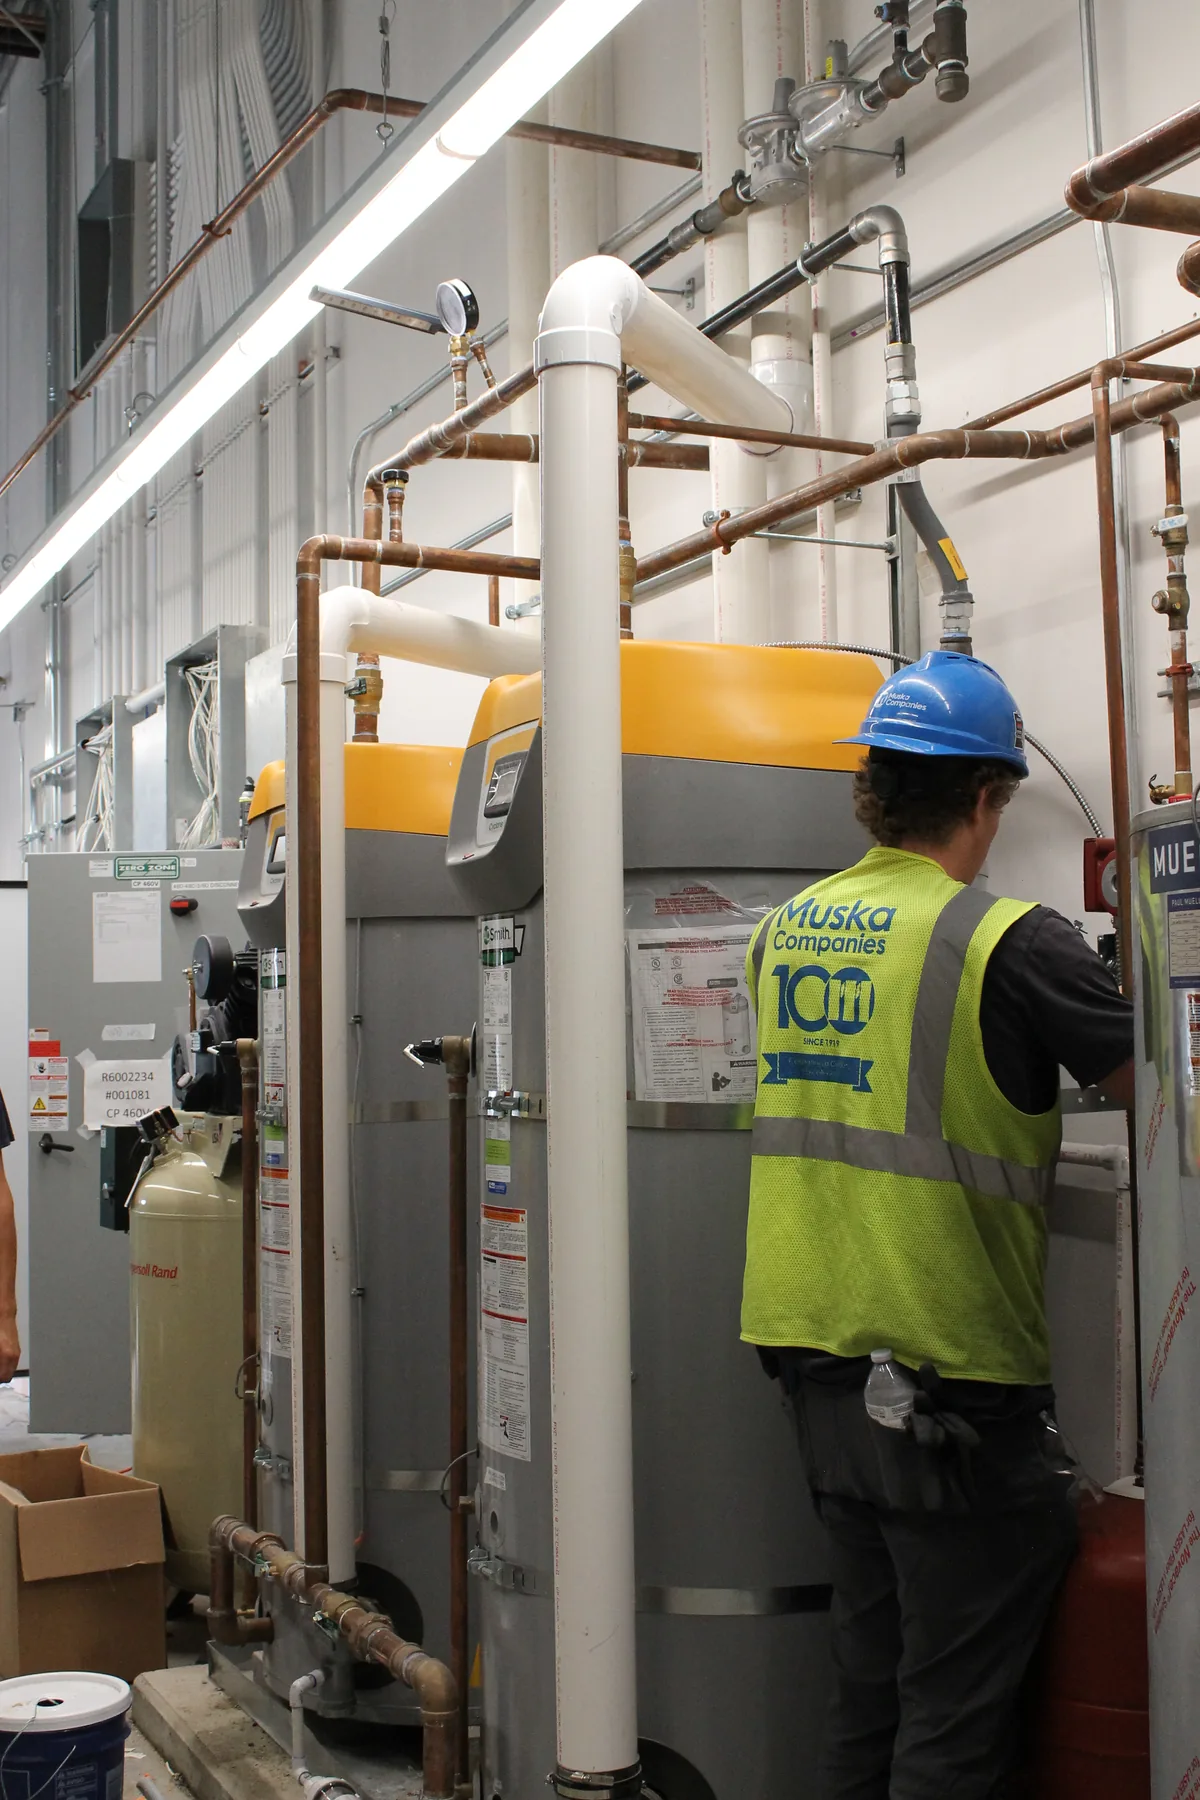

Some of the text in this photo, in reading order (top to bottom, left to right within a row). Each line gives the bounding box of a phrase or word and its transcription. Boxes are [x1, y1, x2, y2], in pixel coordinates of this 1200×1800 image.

[888, 692, 911, 701] Muska
[885, 698, 927, 711] Companies
[1153, 839, 1200, 878] MUE
[776, 897, 898, 932] Muska
[773, 930, 886, 956] Companies
[803, 1037, 840, 1047] SINCE 1919
[101, 1072, 154, 1082] R6002234
[105, 1090, 150, 1100] #001081
[106, 1108, 149, 1118] CP 460V
[152, 1265, 178, 1279] Rand
